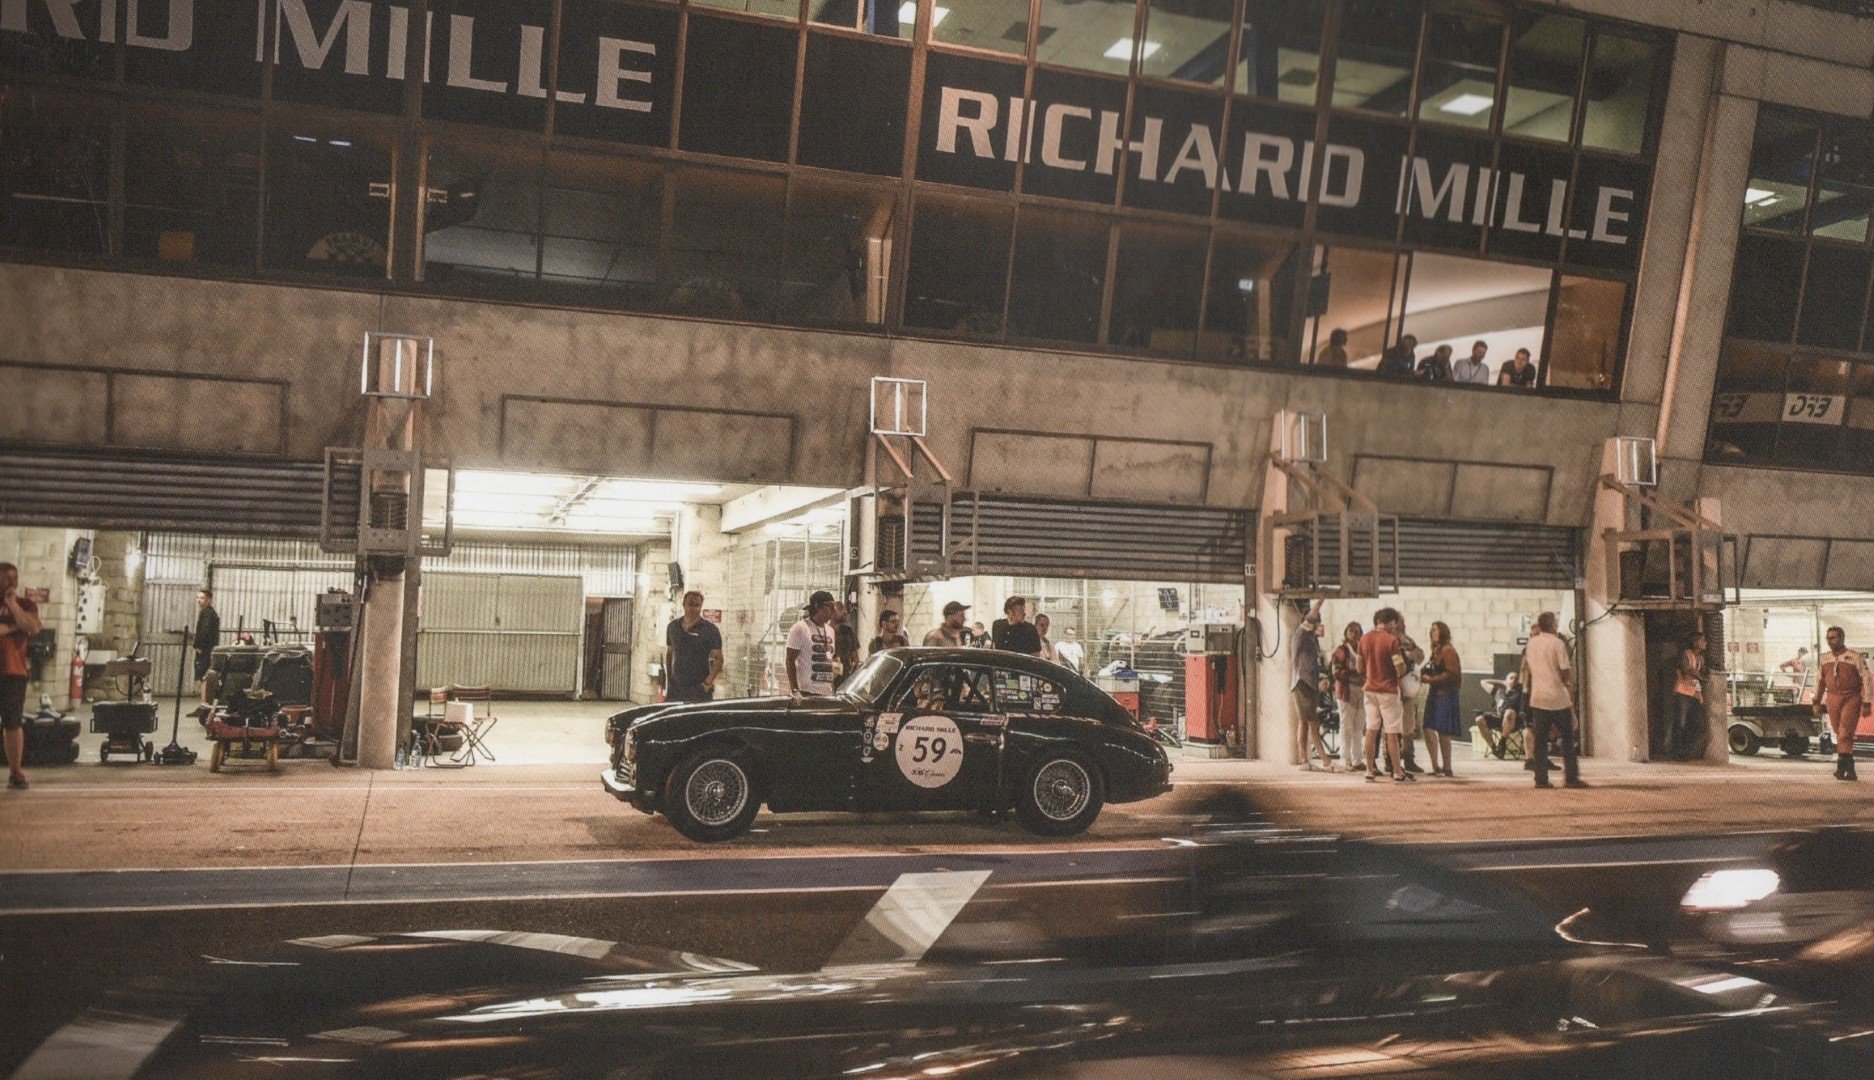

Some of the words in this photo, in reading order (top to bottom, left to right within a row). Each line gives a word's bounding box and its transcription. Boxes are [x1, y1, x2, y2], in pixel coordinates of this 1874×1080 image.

[255, 0, 656, 112] MILLE
[935, 86, 1364, 208] RICHARD
[1395, 155, 1634, 245] MILLE
[912, 736, 947, 764] 59
